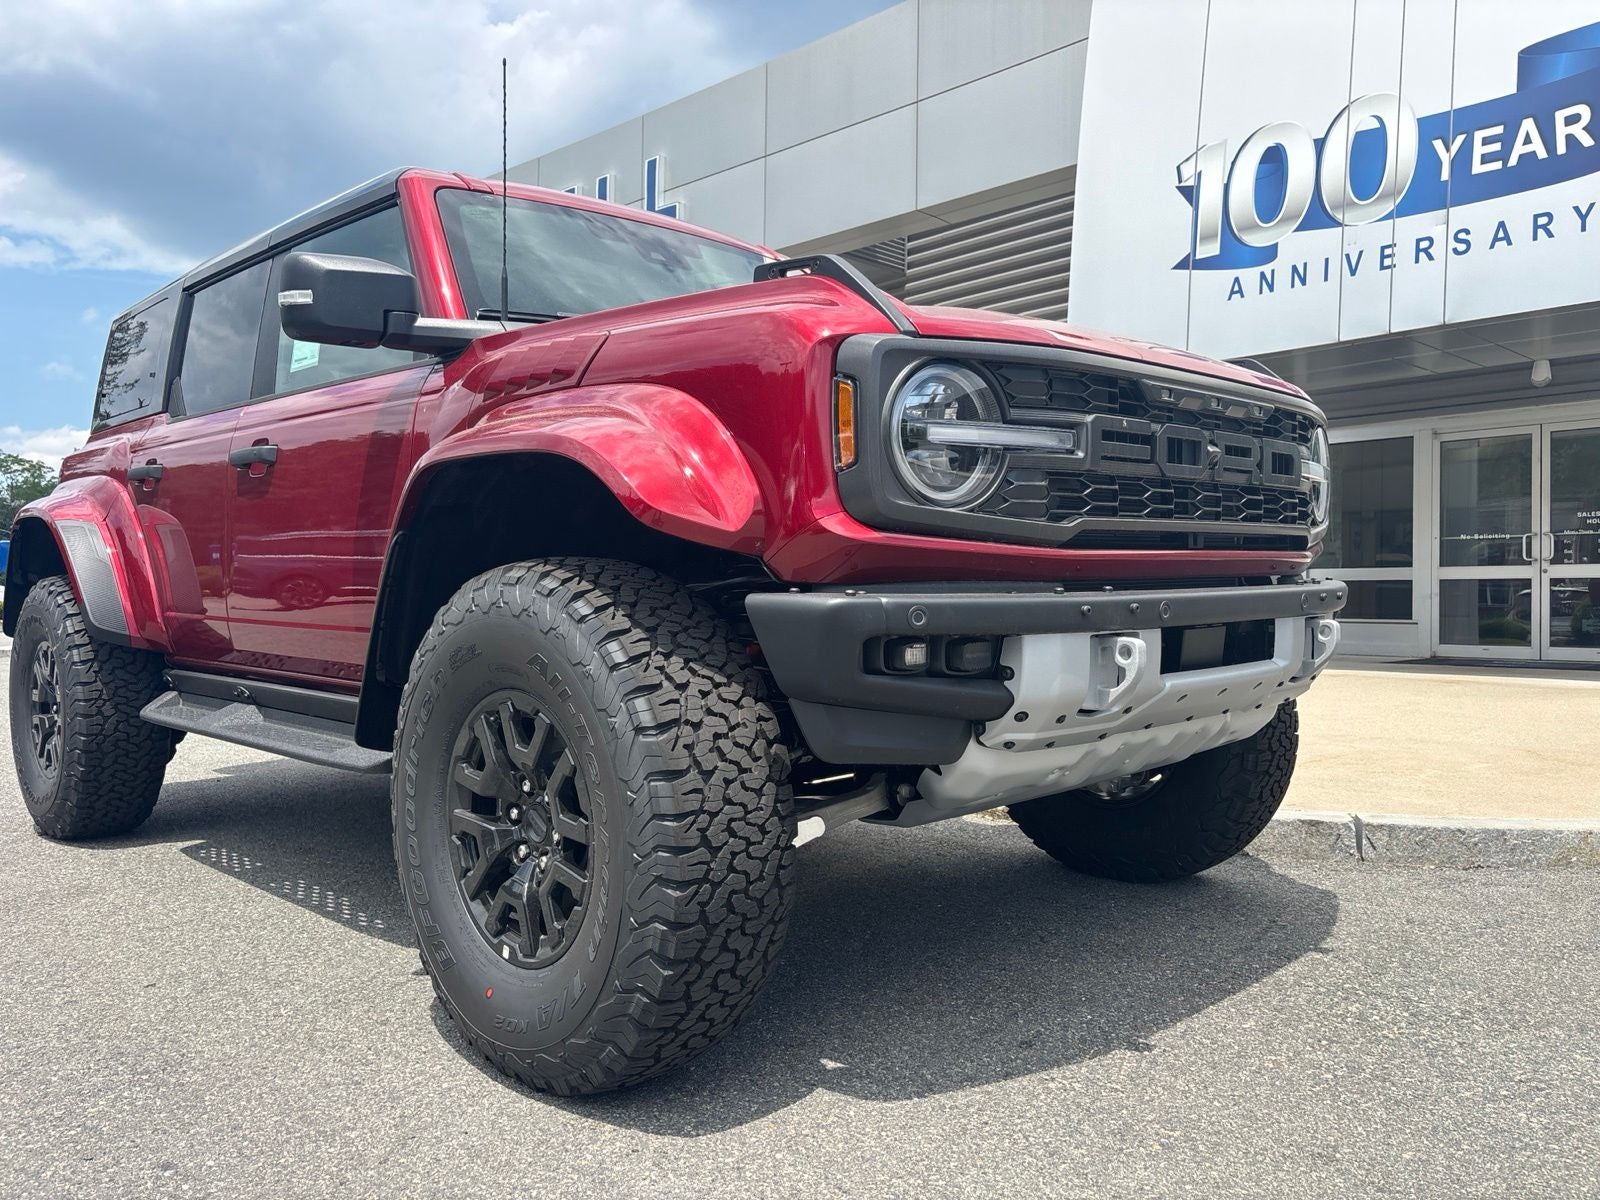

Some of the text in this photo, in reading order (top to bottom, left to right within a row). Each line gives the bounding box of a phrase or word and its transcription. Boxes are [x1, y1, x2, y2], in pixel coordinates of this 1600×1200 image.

[1175, 91, 1596, 260] 100 YEAR
[1227, 201, 1597, 301] ANNIVERSARY
[1087, 413, 1301, 490] FORD
[405, 667, 457, 972] BFGoodrich
